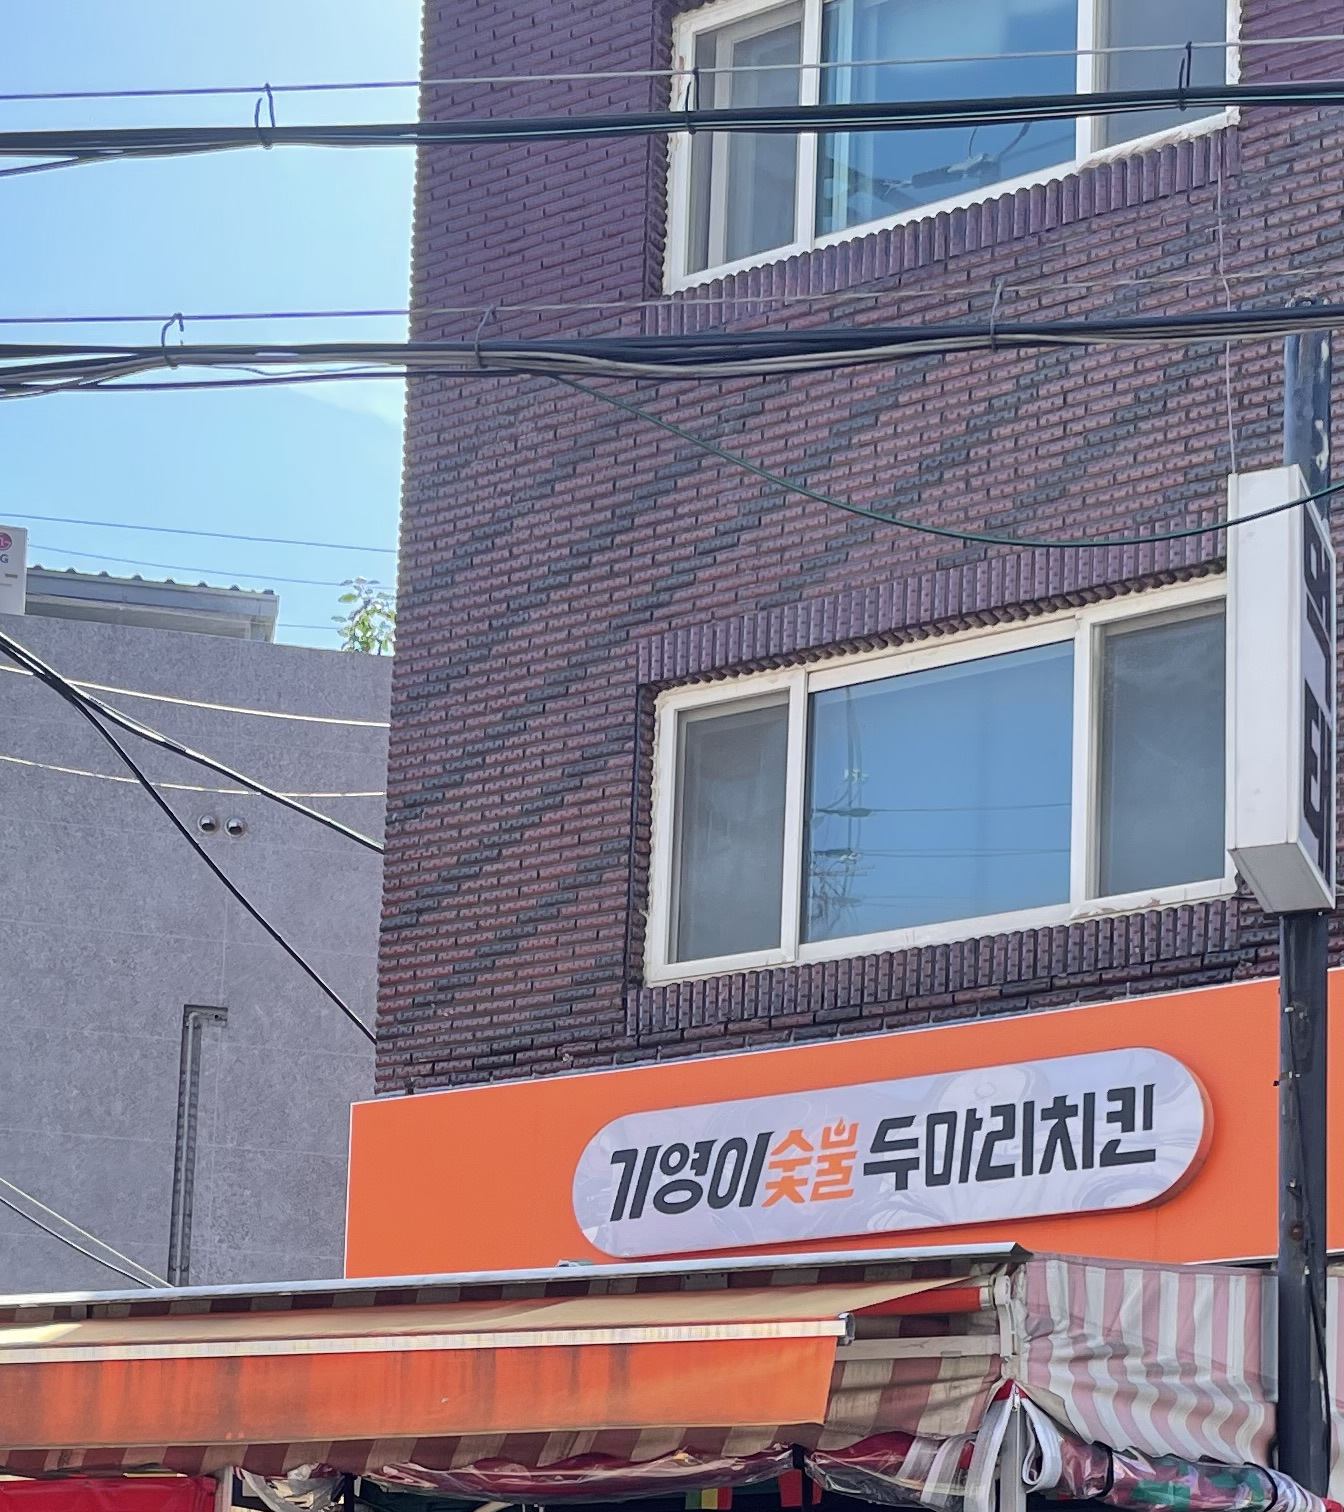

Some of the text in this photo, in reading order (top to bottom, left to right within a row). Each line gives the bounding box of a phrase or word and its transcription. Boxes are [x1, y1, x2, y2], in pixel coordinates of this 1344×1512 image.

[609, 1083, 1158, 1222] 기영이 숯불 두마리치킨
